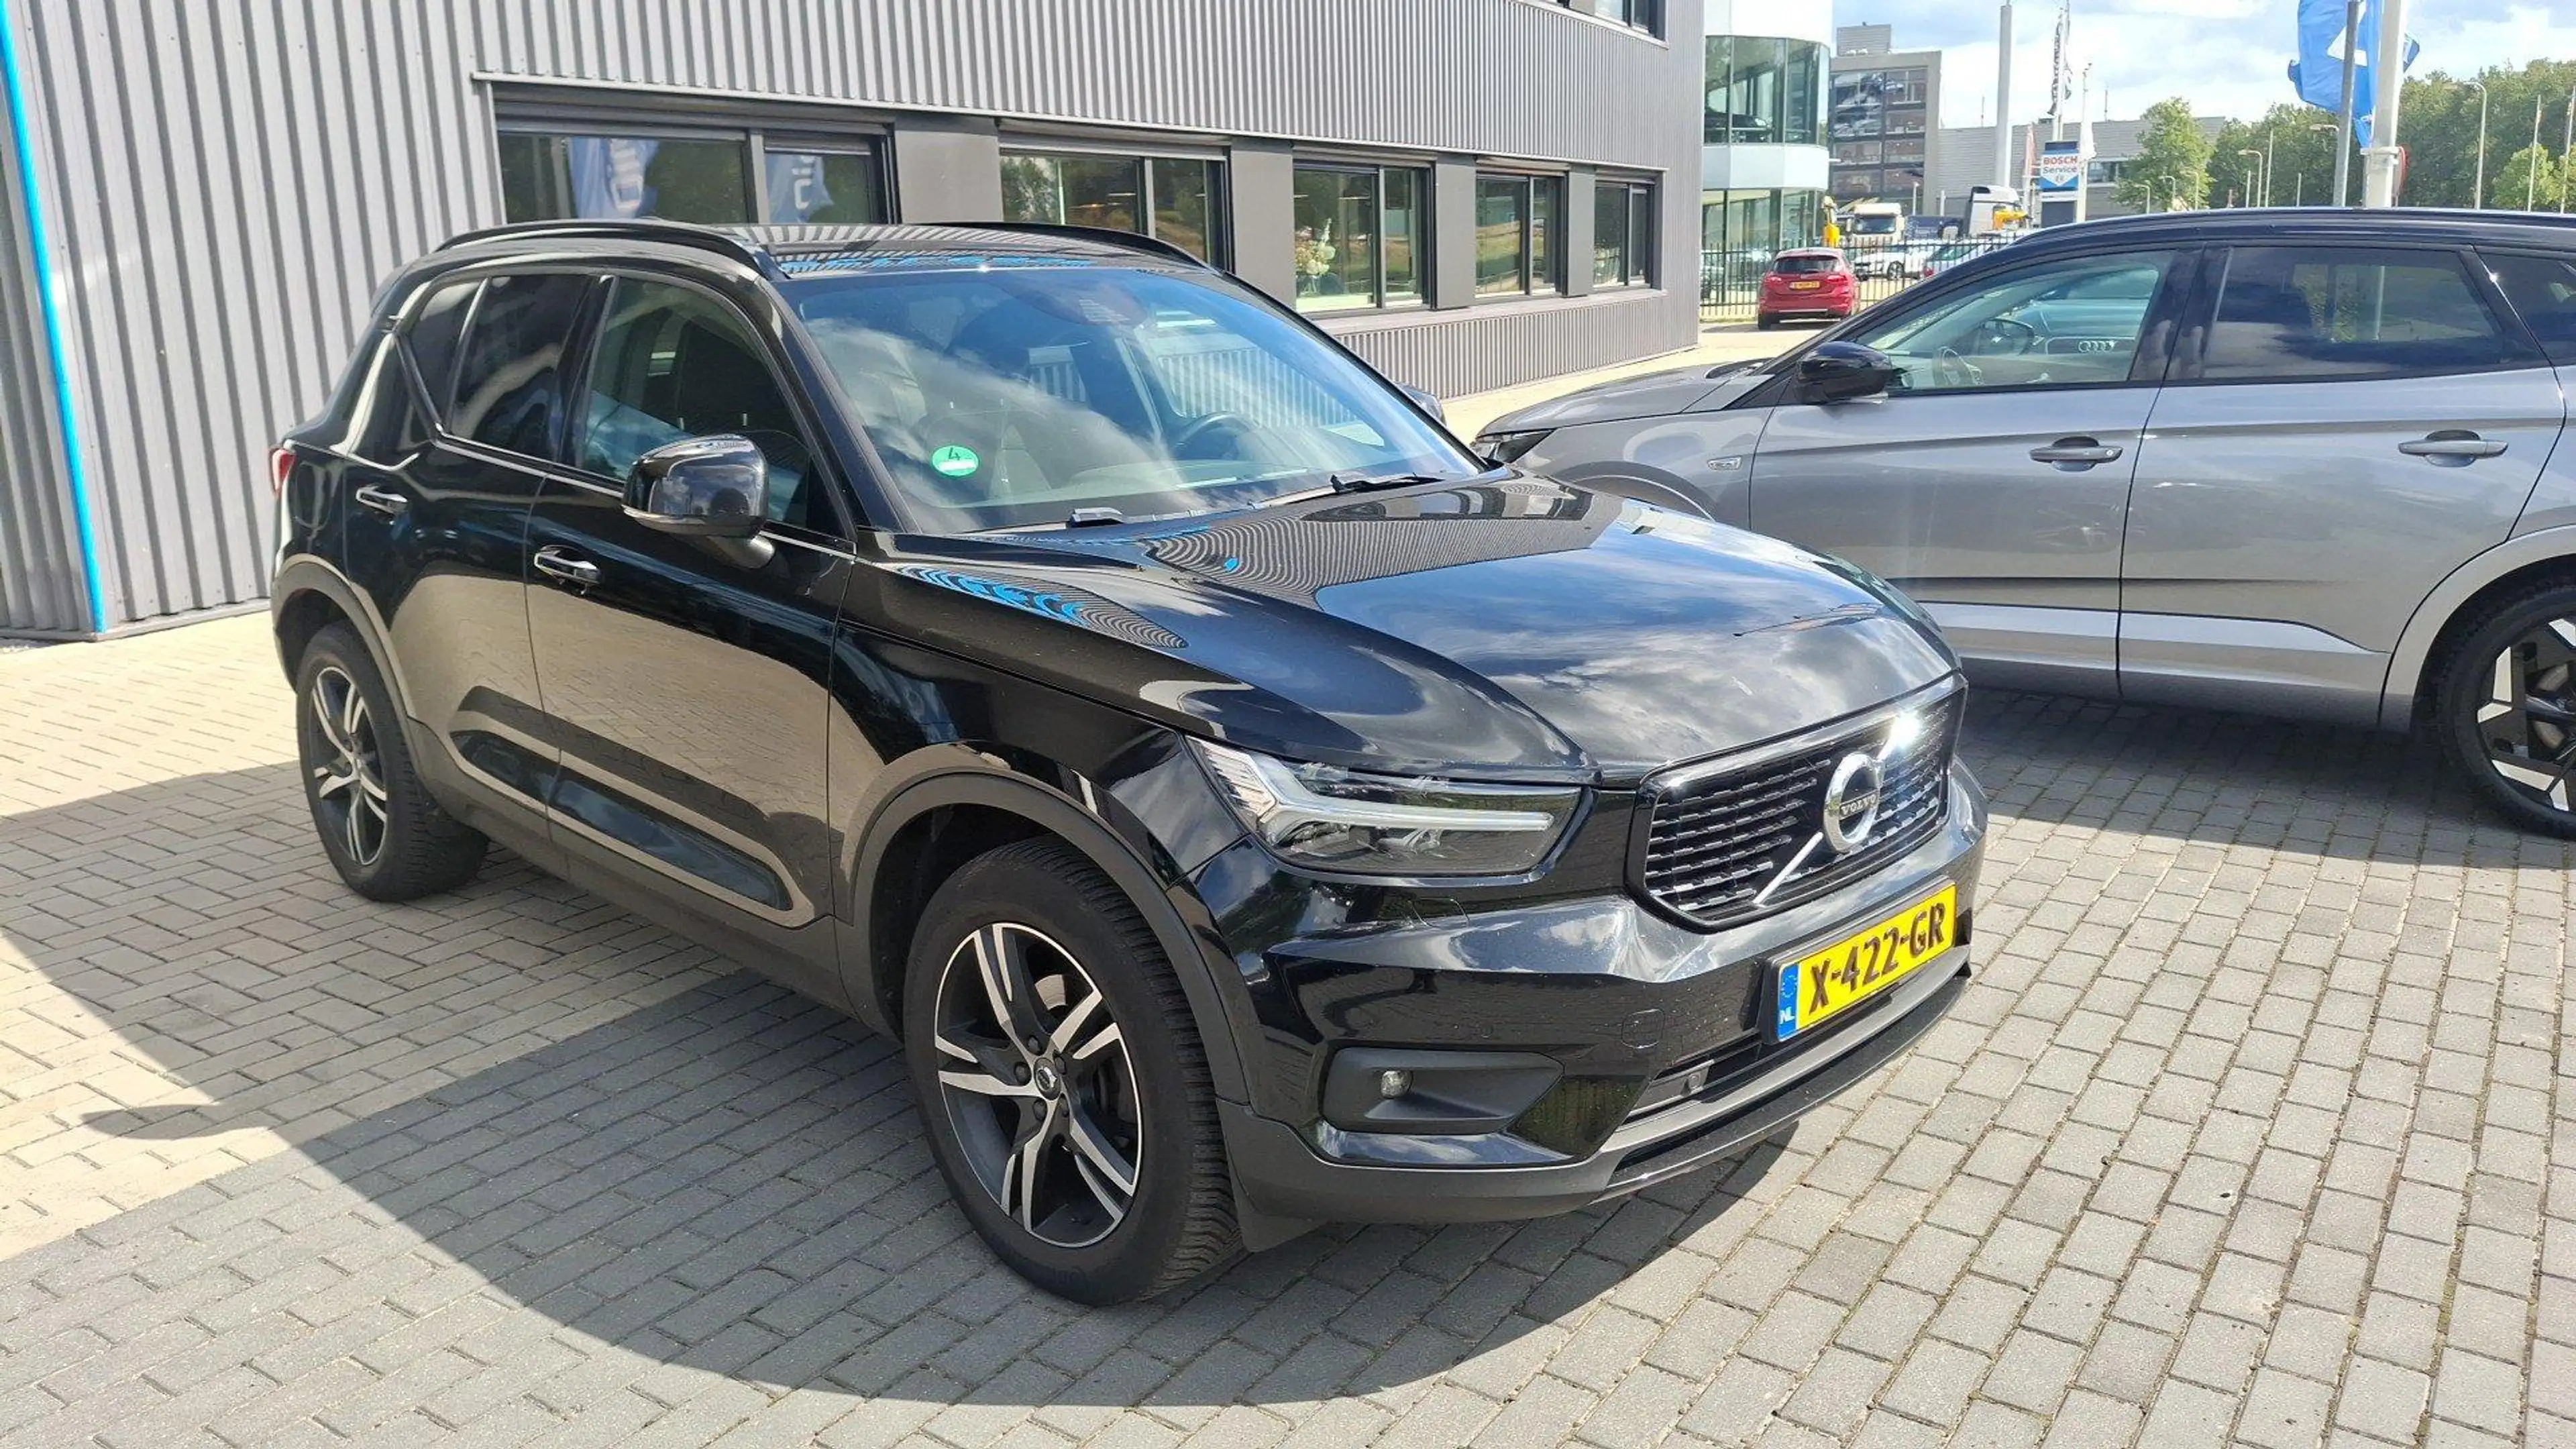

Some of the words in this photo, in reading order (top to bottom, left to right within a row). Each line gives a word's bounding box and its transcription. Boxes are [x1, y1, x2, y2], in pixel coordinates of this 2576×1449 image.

[2043, 156, 2078, 165] BOSCH
[949, 447, 961, 461] 4
[1840, 793, 1876, 816] VOLVO
[1809, 902, 1945, 1016] X-422-GR
[1779, 1006, 1795, 1024] NL
